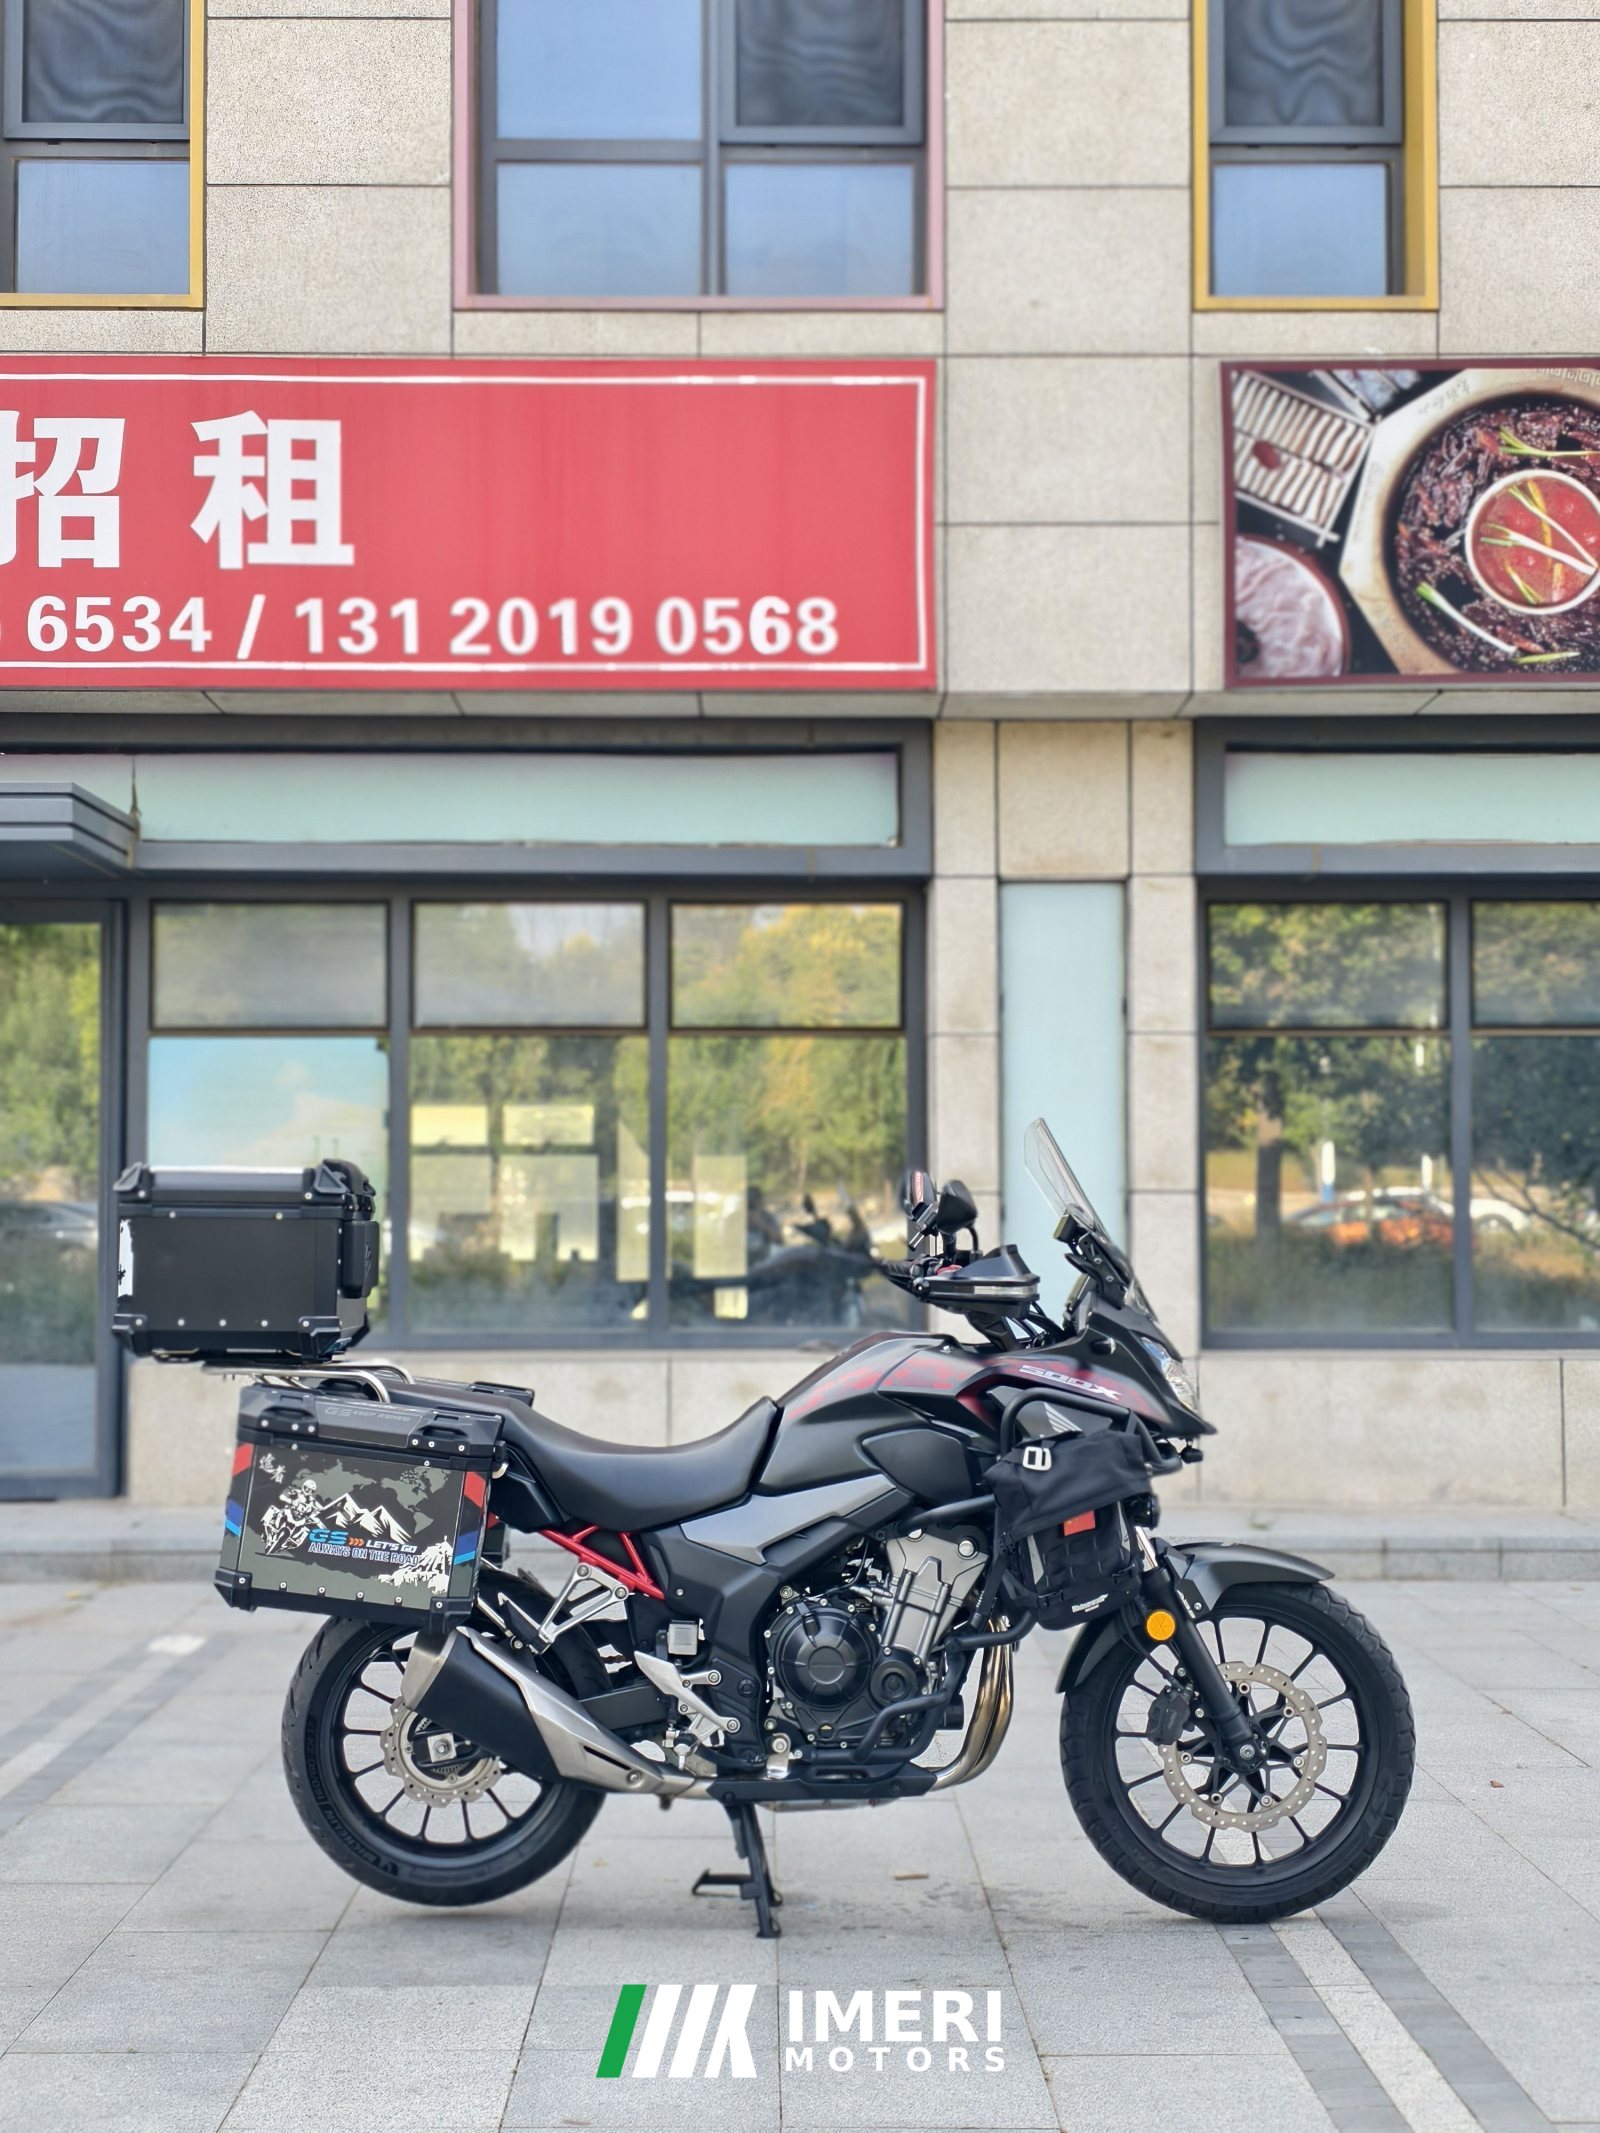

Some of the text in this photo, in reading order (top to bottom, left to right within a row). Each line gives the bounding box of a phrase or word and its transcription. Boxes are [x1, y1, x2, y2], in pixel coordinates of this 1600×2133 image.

[0, 410, 355, 570] 招租
[27, 595, 838, 660] 6534 / 131 2019 0568
[308, 1528, 418, 1553] GS LET'S GO
[308, 1542, 420, 1566] ALWAYS ON THE ROAD
